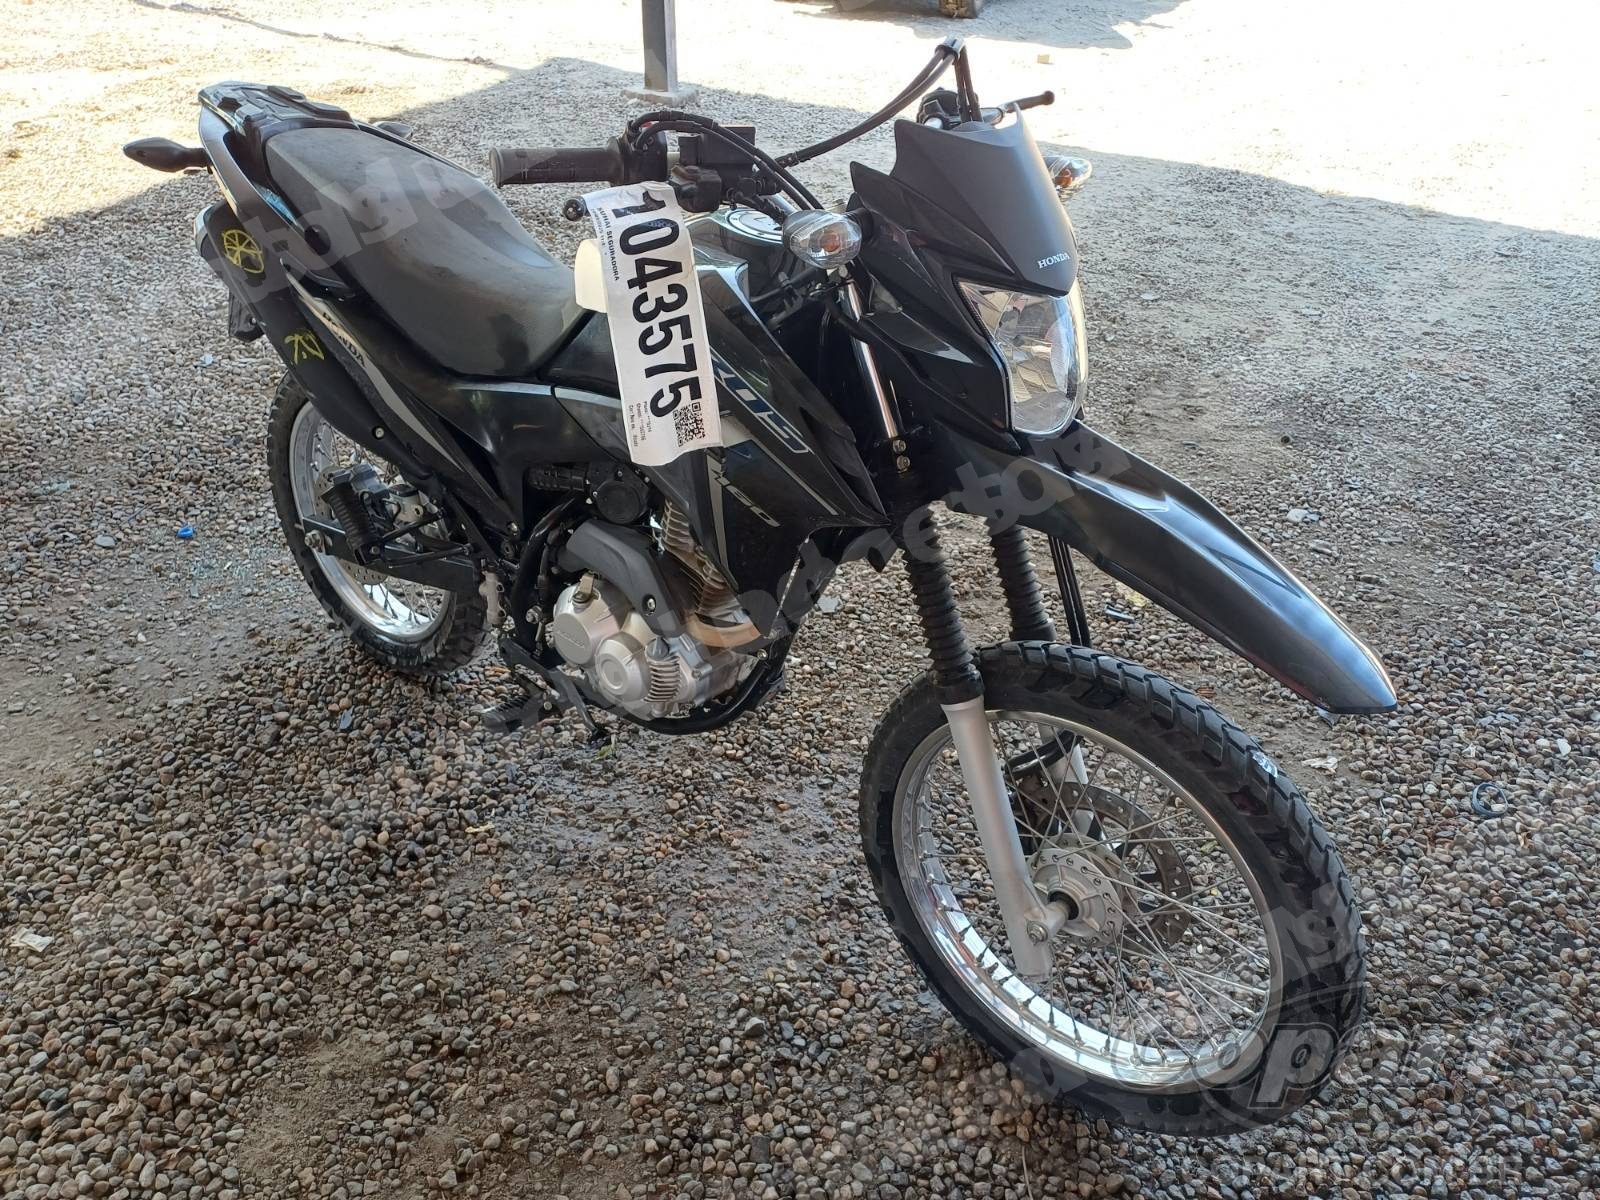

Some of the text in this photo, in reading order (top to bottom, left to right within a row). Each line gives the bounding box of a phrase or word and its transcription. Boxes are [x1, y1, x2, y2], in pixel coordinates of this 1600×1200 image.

[606, 230, 620, 282] SEGURADORA
[1037, 252, 1070, 269] HONDA
[612, 190, 702, 418] 1043575
